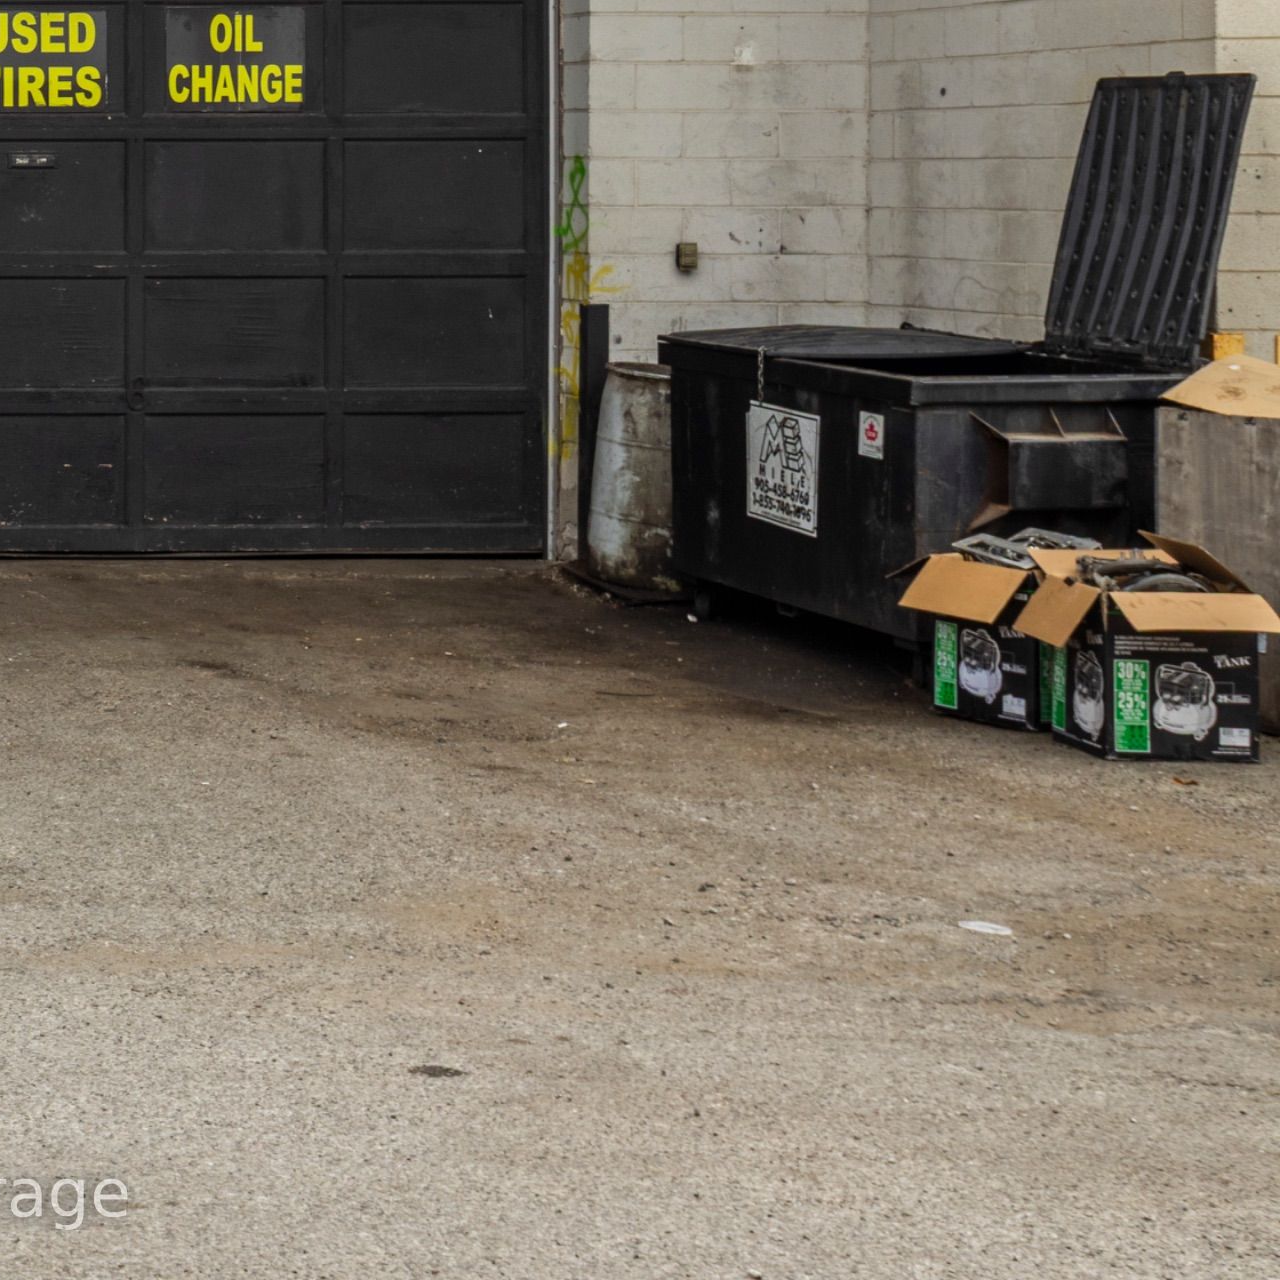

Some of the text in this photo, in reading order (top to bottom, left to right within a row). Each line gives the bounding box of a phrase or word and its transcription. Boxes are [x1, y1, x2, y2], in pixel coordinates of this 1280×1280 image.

[209, 13, 263, 53] OIL
[168, 64, 303, 104] CHANGE
[1118, 661, 1146, 680] 30%
[1118, 692, 1146, 710] 25%
